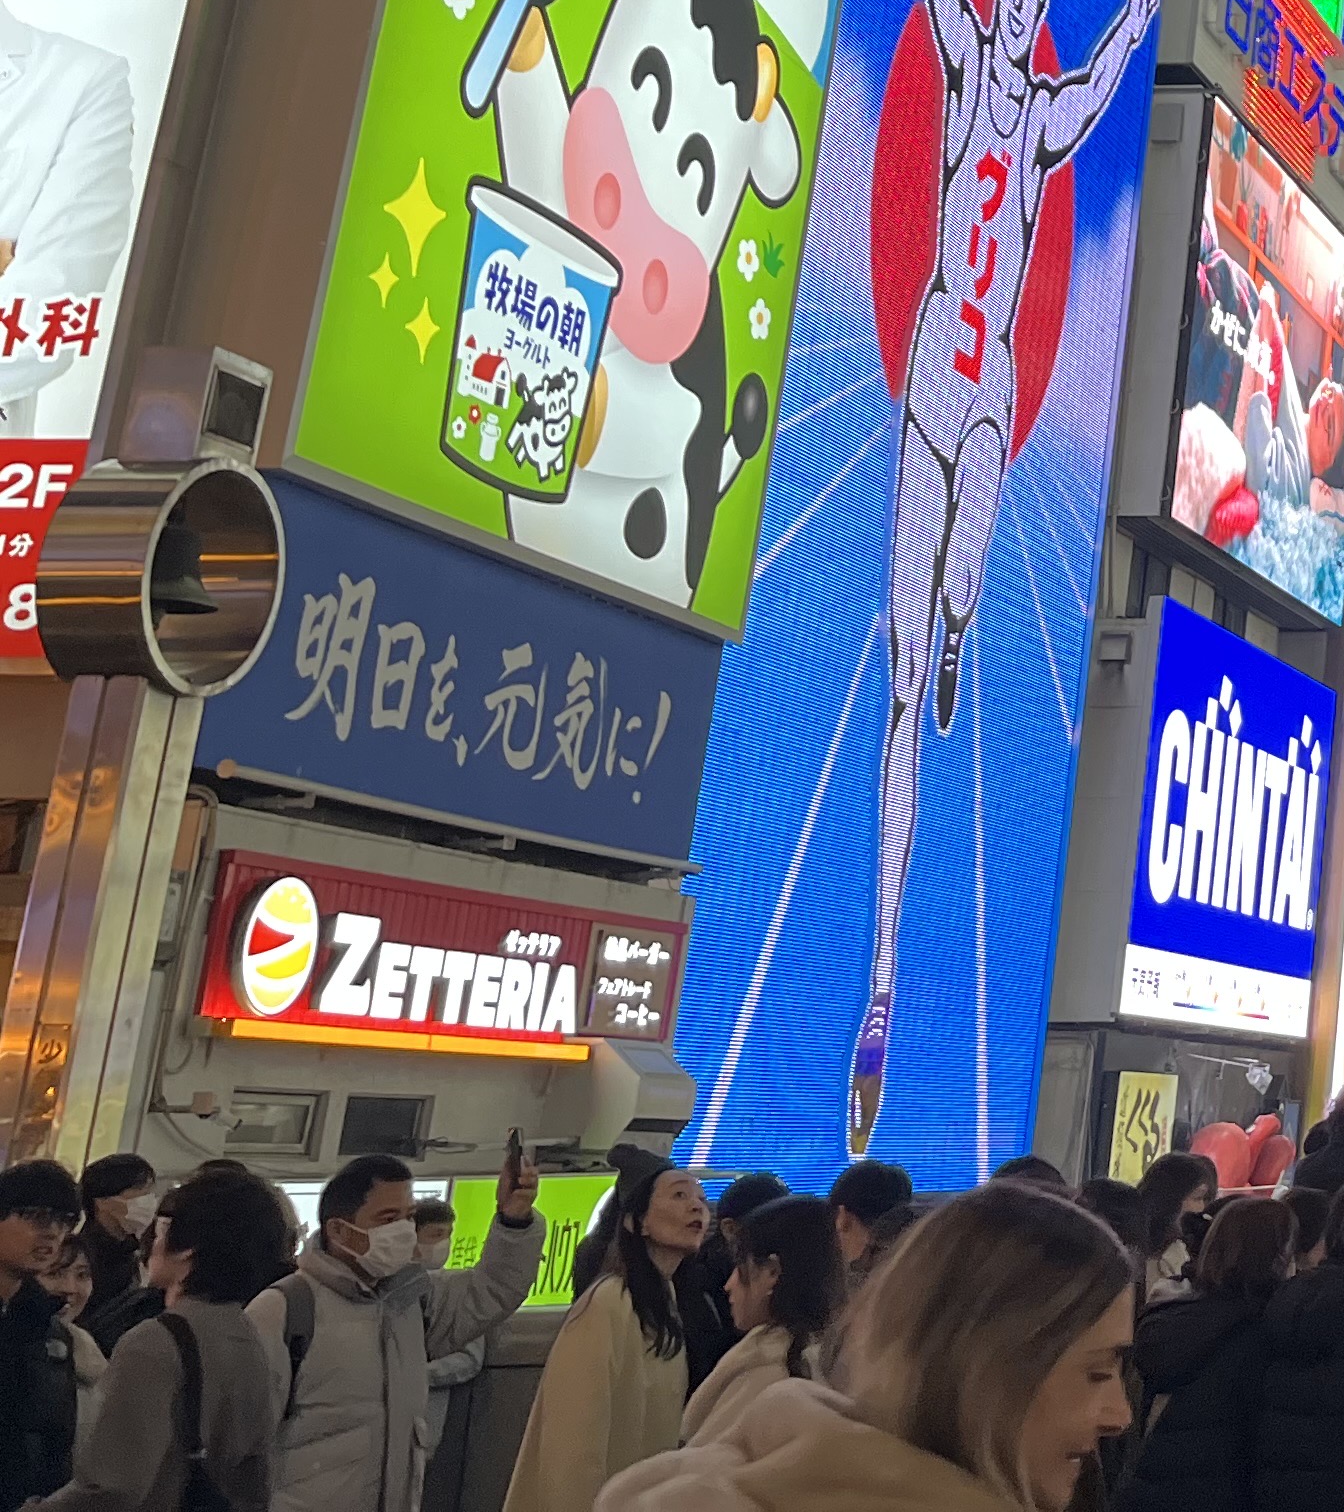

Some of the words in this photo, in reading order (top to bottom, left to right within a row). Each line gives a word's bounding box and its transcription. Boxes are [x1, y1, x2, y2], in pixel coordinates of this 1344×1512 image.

[953, 145, 1012, 386] グリコ
[483, 261, 587, 358] 牧場の朝
[503, 329, 552, 370] ヨーグルト
[0, 463, 73, 509] 2F
[1149, 693, 1320, 930] CHINTAI
[318, 911, 579, 1035] ZETTERIA
[503, 928, 562, 958] ゼッテリア
[615, 1003, 660, 1026] コーヒー
